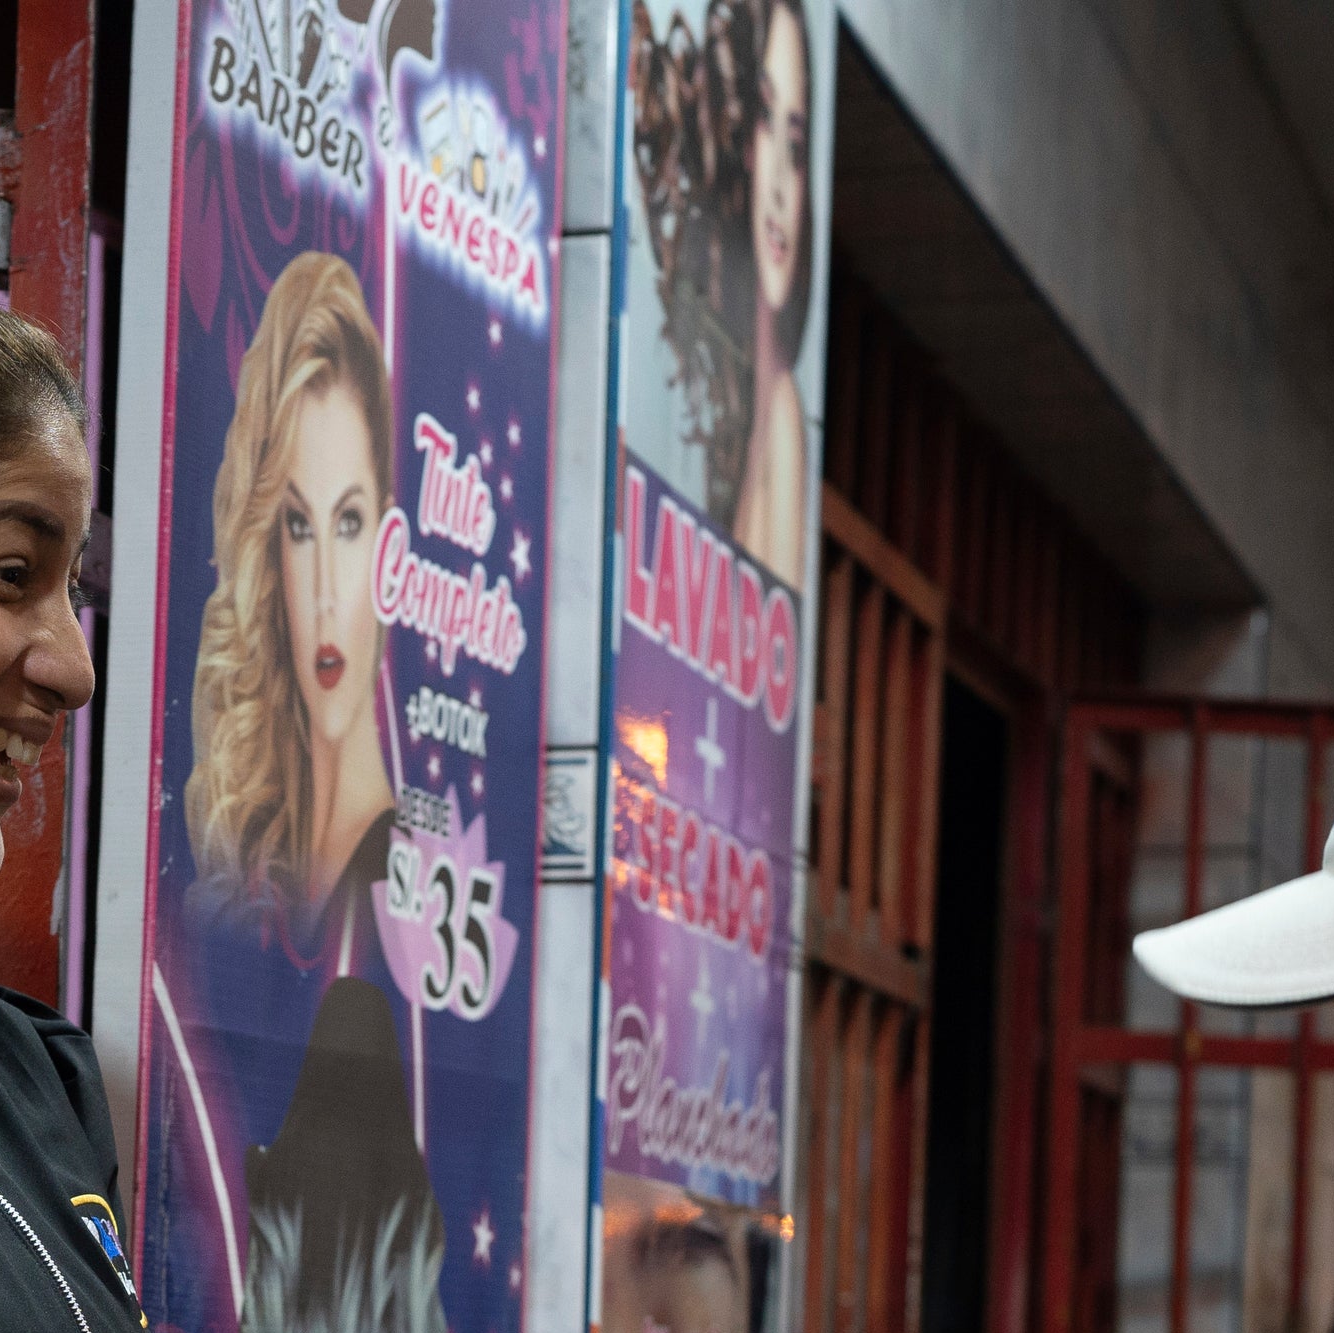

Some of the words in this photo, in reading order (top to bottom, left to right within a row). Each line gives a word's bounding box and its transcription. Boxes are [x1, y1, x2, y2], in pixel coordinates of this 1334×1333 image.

[209, 34, 366, 190] BARBER
[398, 162, 542, 306] VENESPA
[374, 506, 528, 677] Completo
[623, 464, 800, 734] LAVADO
[426, 855, 499, 1021] 35
[635, 795, 768, 960] SECADO
